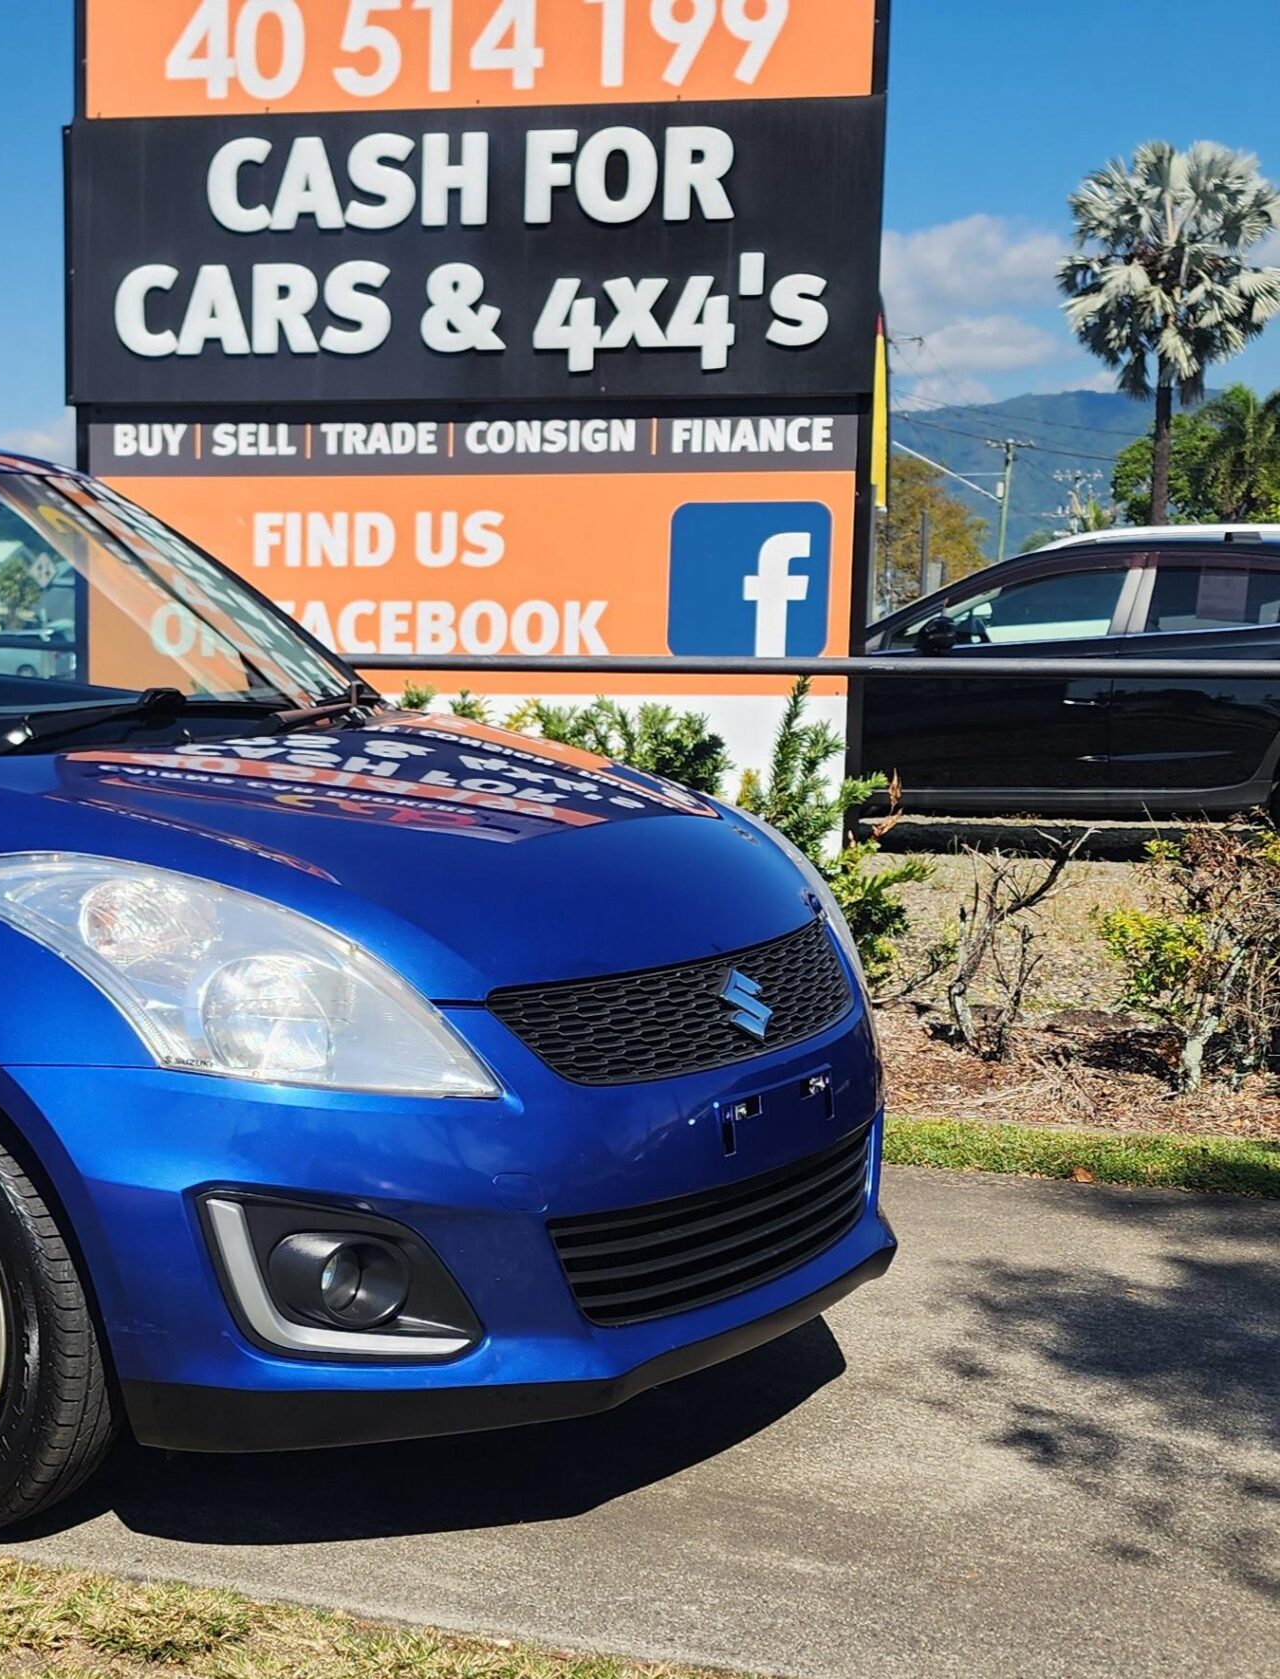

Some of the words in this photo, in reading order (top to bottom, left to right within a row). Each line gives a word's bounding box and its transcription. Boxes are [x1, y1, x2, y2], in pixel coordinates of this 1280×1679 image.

[166, 0, 305, 99] 40
[333, 0, 544, 97] 514
[586, 0, 789, 87] 199
[207, 132, 489, 232] CASH
[524, 126, 735, 223] FOR
[114, 260, 392, 357] CARS
[420, 262, 507, 353] &
[114, 424, 188, 457] BUY
[211, 422, 298, 457] SELL
[320, 421, 438, 456] TRADE
[464, 418, 637, 455] CONSIGN
[671, 416, 834, 453] FINANCE
[253, 511, 396, 568] FIND
[415, 510, 505, 568] US
